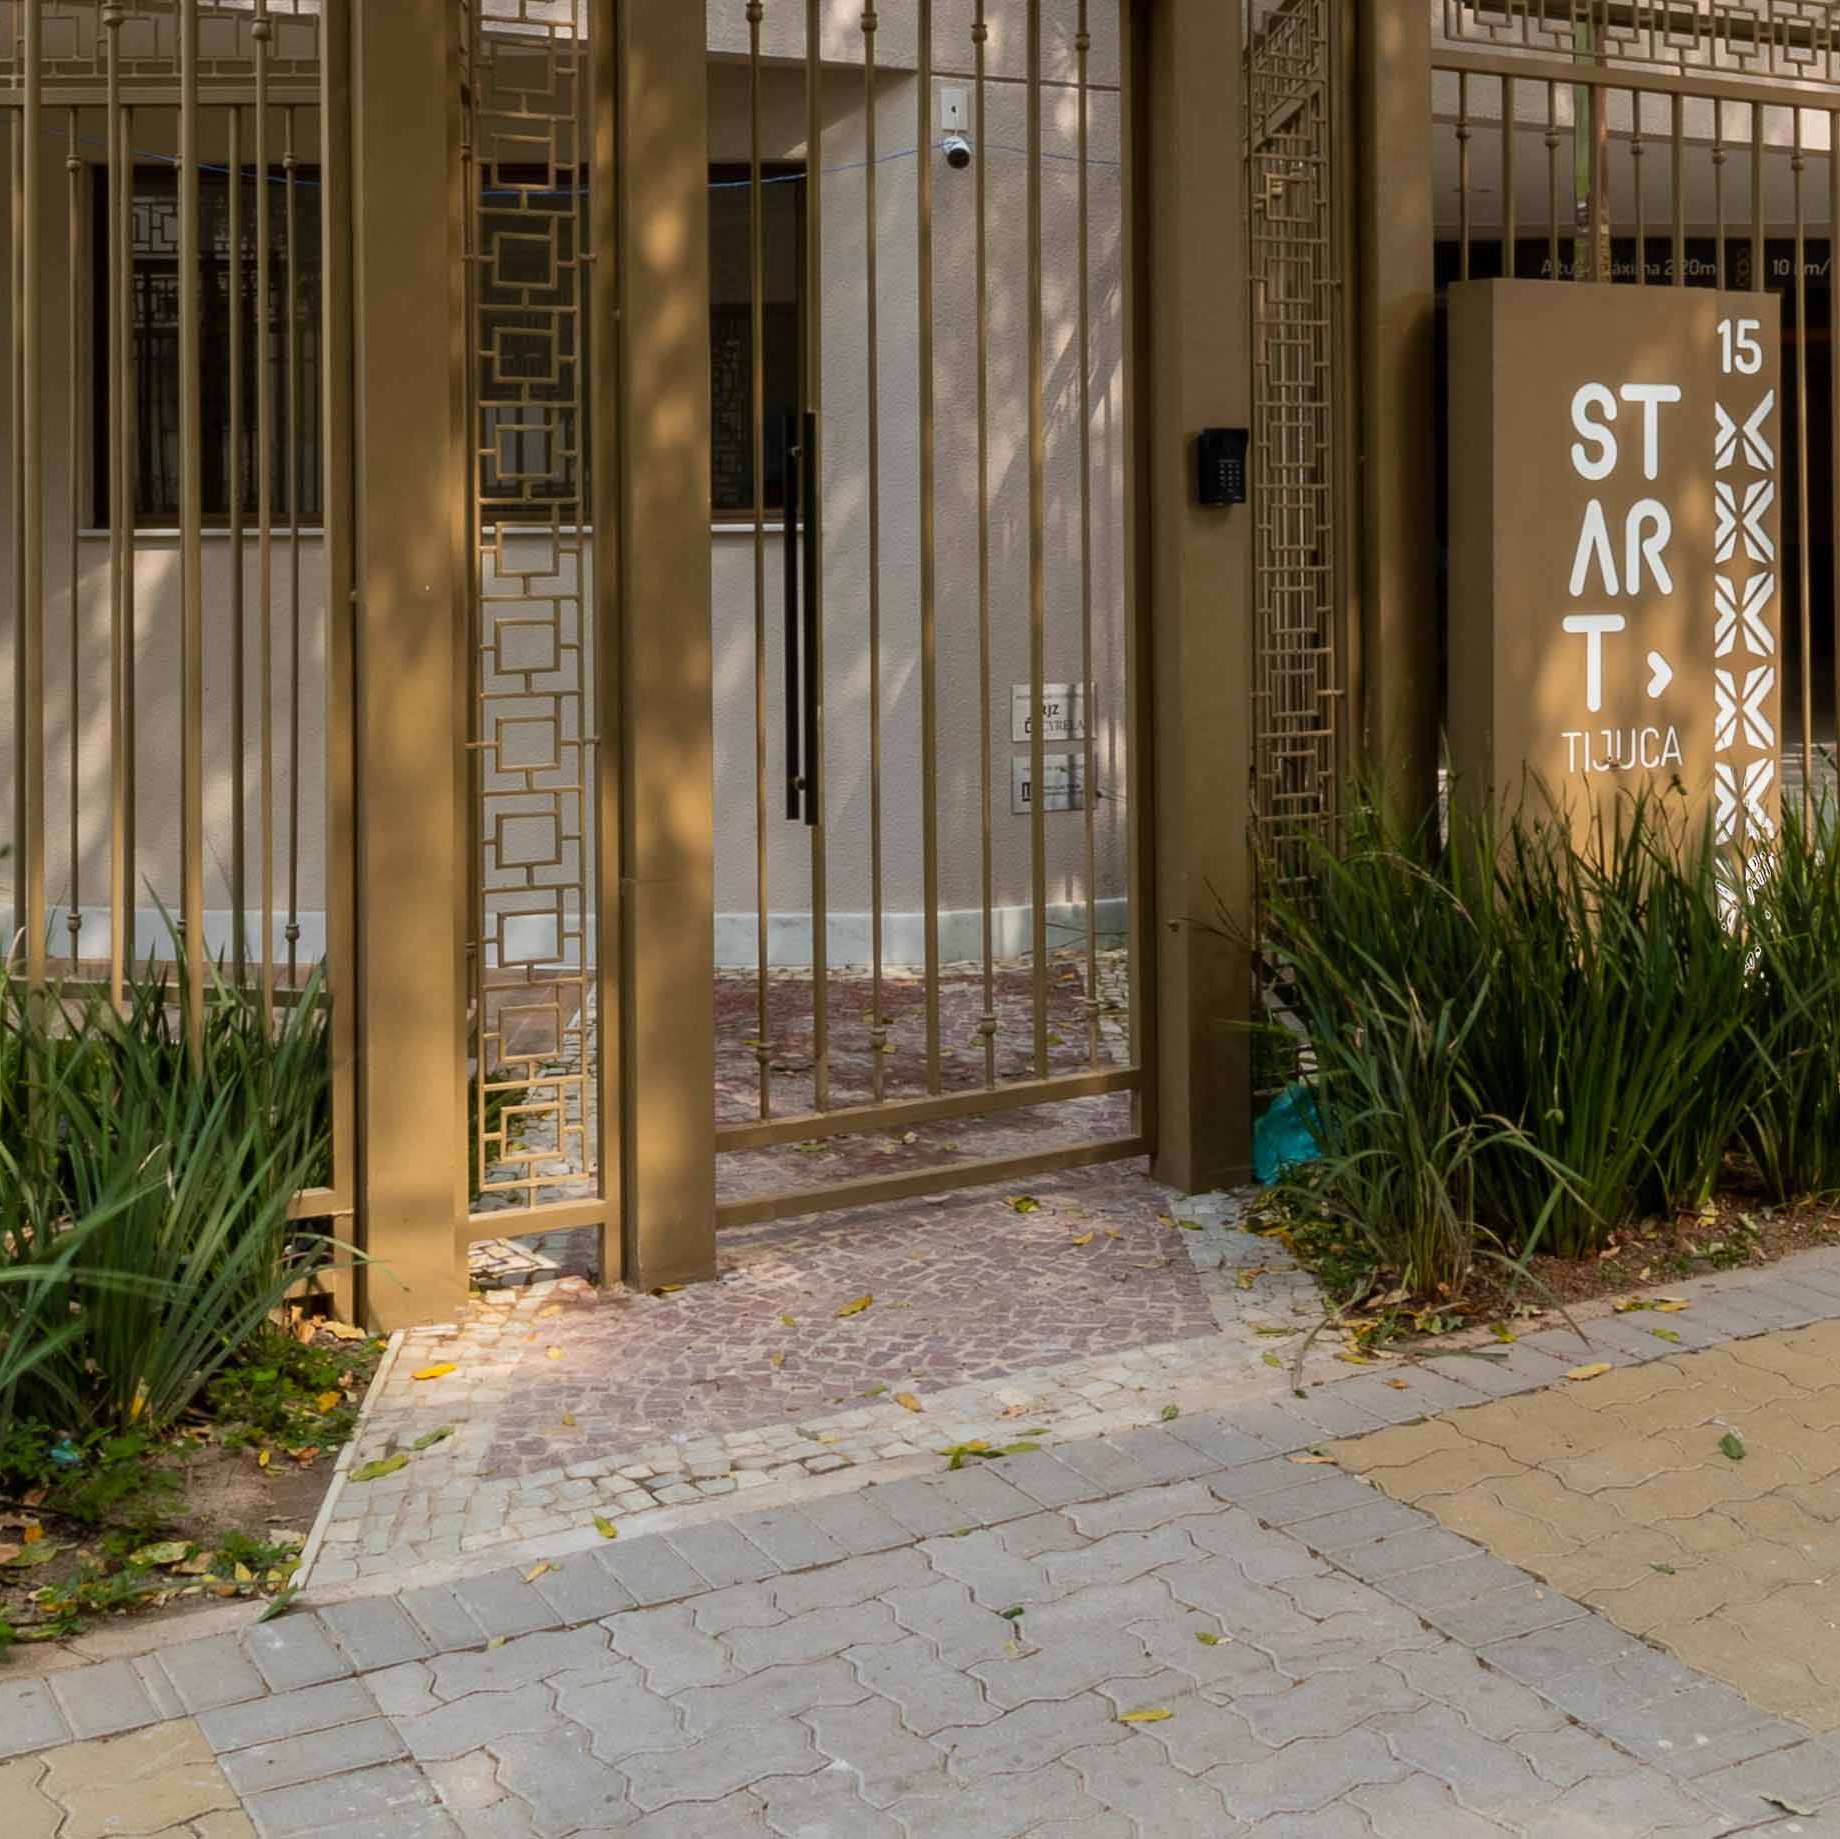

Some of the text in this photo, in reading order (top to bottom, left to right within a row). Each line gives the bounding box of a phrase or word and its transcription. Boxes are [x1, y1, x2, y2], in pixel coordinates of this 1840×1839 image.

[1772, 258, 1790, 276] 10
[1717, 319, 1763, 374] 15
[1571, 382, 1682, 480] ST
[1569, 499, 1673, 596] AR
[1562, 726, 1683, 773] TIJUCA
